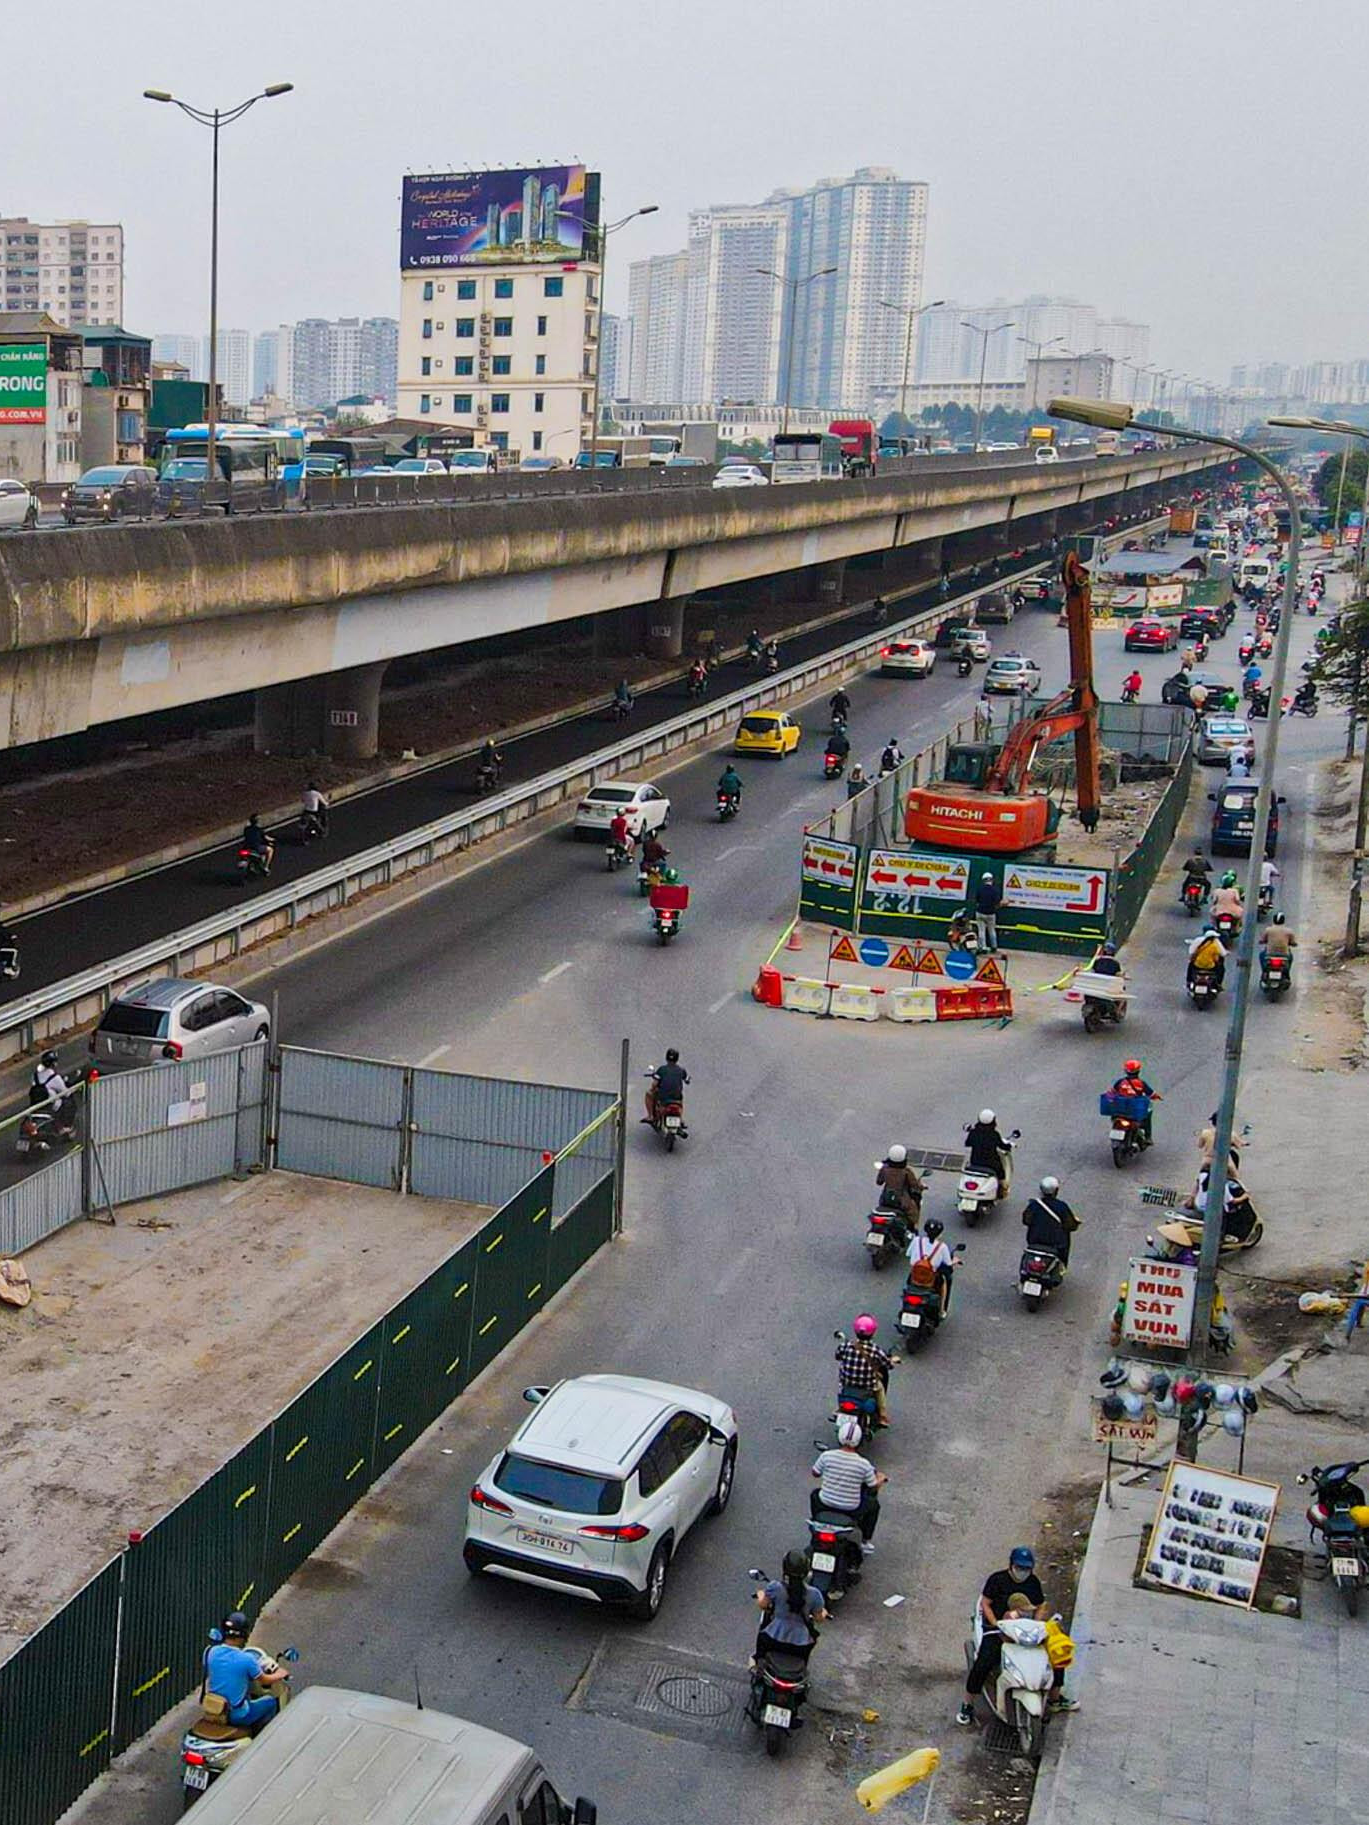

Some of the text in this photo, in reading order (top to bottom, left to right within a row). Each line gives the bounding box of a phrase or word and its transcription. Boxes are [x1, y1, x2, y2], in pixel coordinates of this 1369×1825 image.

[412, 216, 478, 229] HERITAGE
[931, 805, 984, 821] HITACHI
[1139, 1264, 1181, 1279] THU
[1137, 1281, 1184, 1298] MUA
